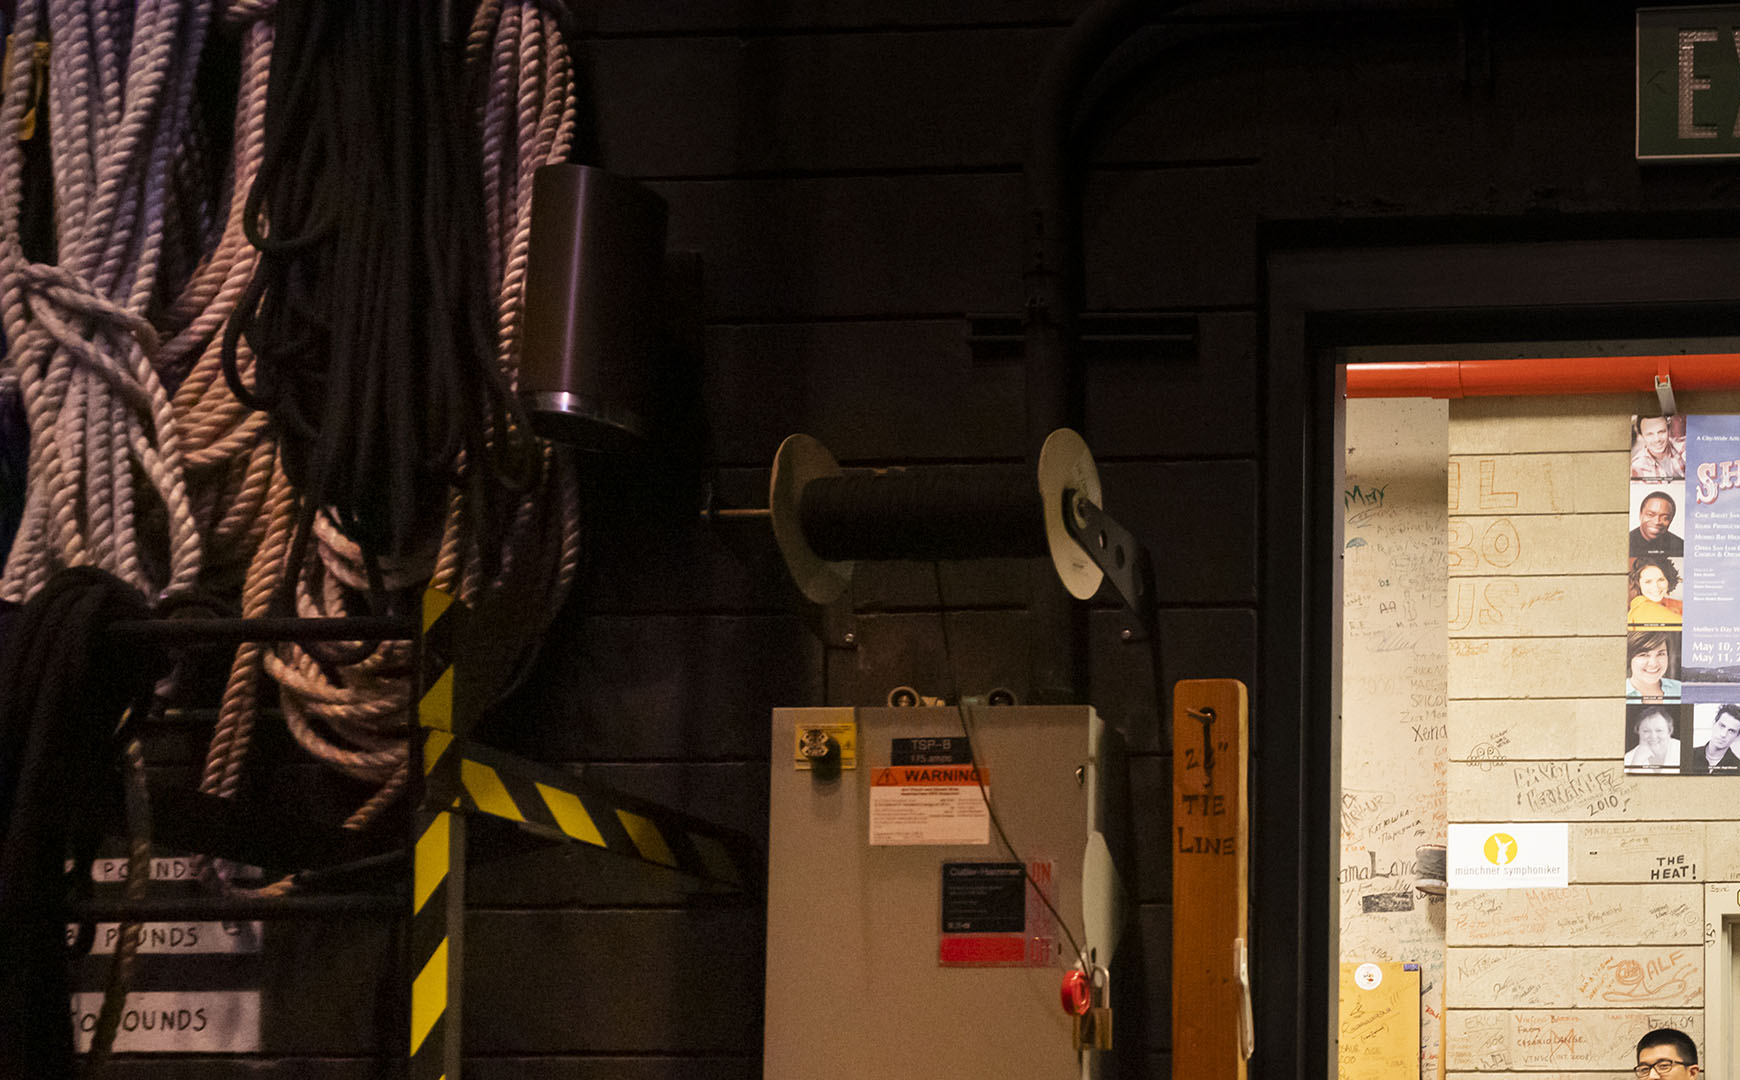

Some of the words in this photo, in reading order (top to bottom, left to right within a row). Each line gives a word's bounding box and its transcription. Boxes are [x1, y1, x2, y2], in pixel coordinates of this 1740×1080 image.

[1692, 641, 1714, 654] May
[1718, 641, 1733, 653] 10,
[1692, 652, 1714, 665] May
[1717, 652, 1733, 664] 11,
[905, 769, 981, 782] WARNING
[1183, 794, 1226, 816] TIE
[1587, 795, 1618, 816] 2010
[1177, 826, 1236, 856] LINE
[104, 861, 201, 878] PONDS
[1656, 855, 1685, 867] THE
[1455, 866, 1501, 875] münchner
[1503, 865, 1561, 877] symphoniker
[1651, 864, 1696, 880] HEAT!
[106, 928, 199, 948] PUNDS
[1647, 950, 1685, 981] ALF
[122, 1008, 207, 1032] OUNDS
